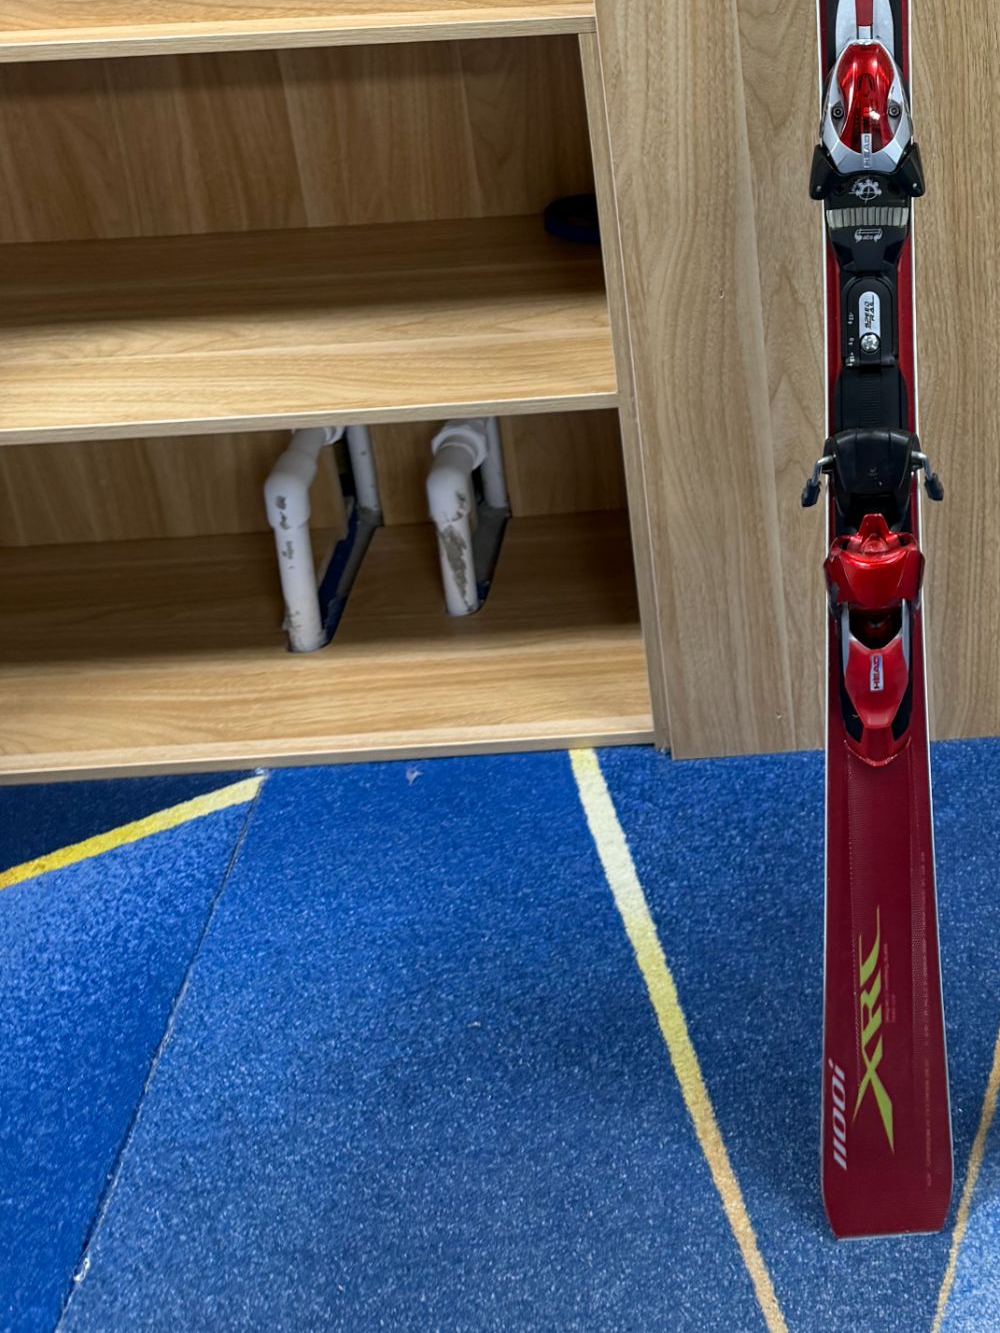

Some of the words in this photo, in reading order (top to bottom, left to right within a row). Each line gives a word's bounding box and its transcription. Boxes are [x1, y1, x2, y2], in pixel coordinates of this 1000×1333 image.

[870, 656, 883, 691] HEAD
[852, 905, 895, 1154] XRC
[828, 1058, 847, 1171] 1100i
